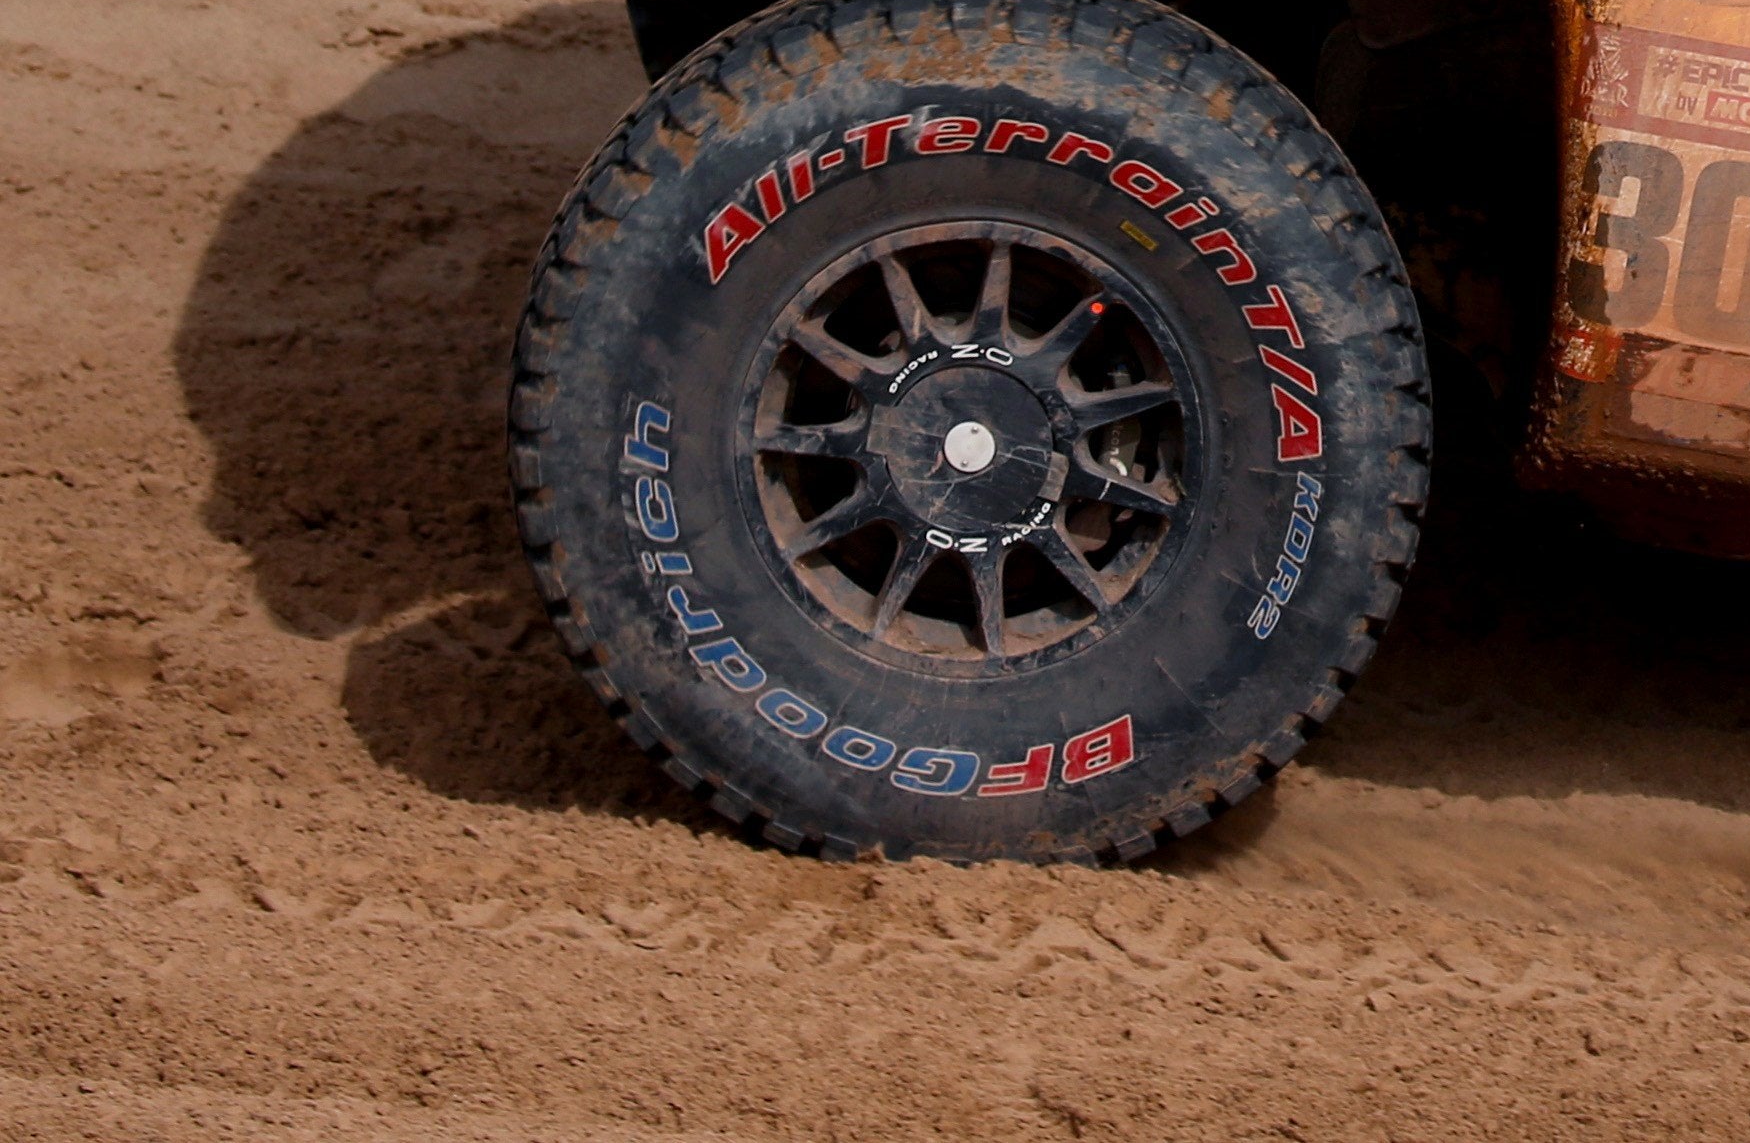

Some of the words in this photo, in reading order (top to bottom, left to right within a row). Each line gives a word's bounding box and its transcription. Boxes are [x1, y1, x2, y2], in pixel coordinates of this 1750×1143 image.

[888, 349, 939, 395] RACING
[1001, 502, 1052, 546] RACING
[1247, 471, 1322, 640] KDR2
[623, 401, 1135, 798] BFGoodrich
